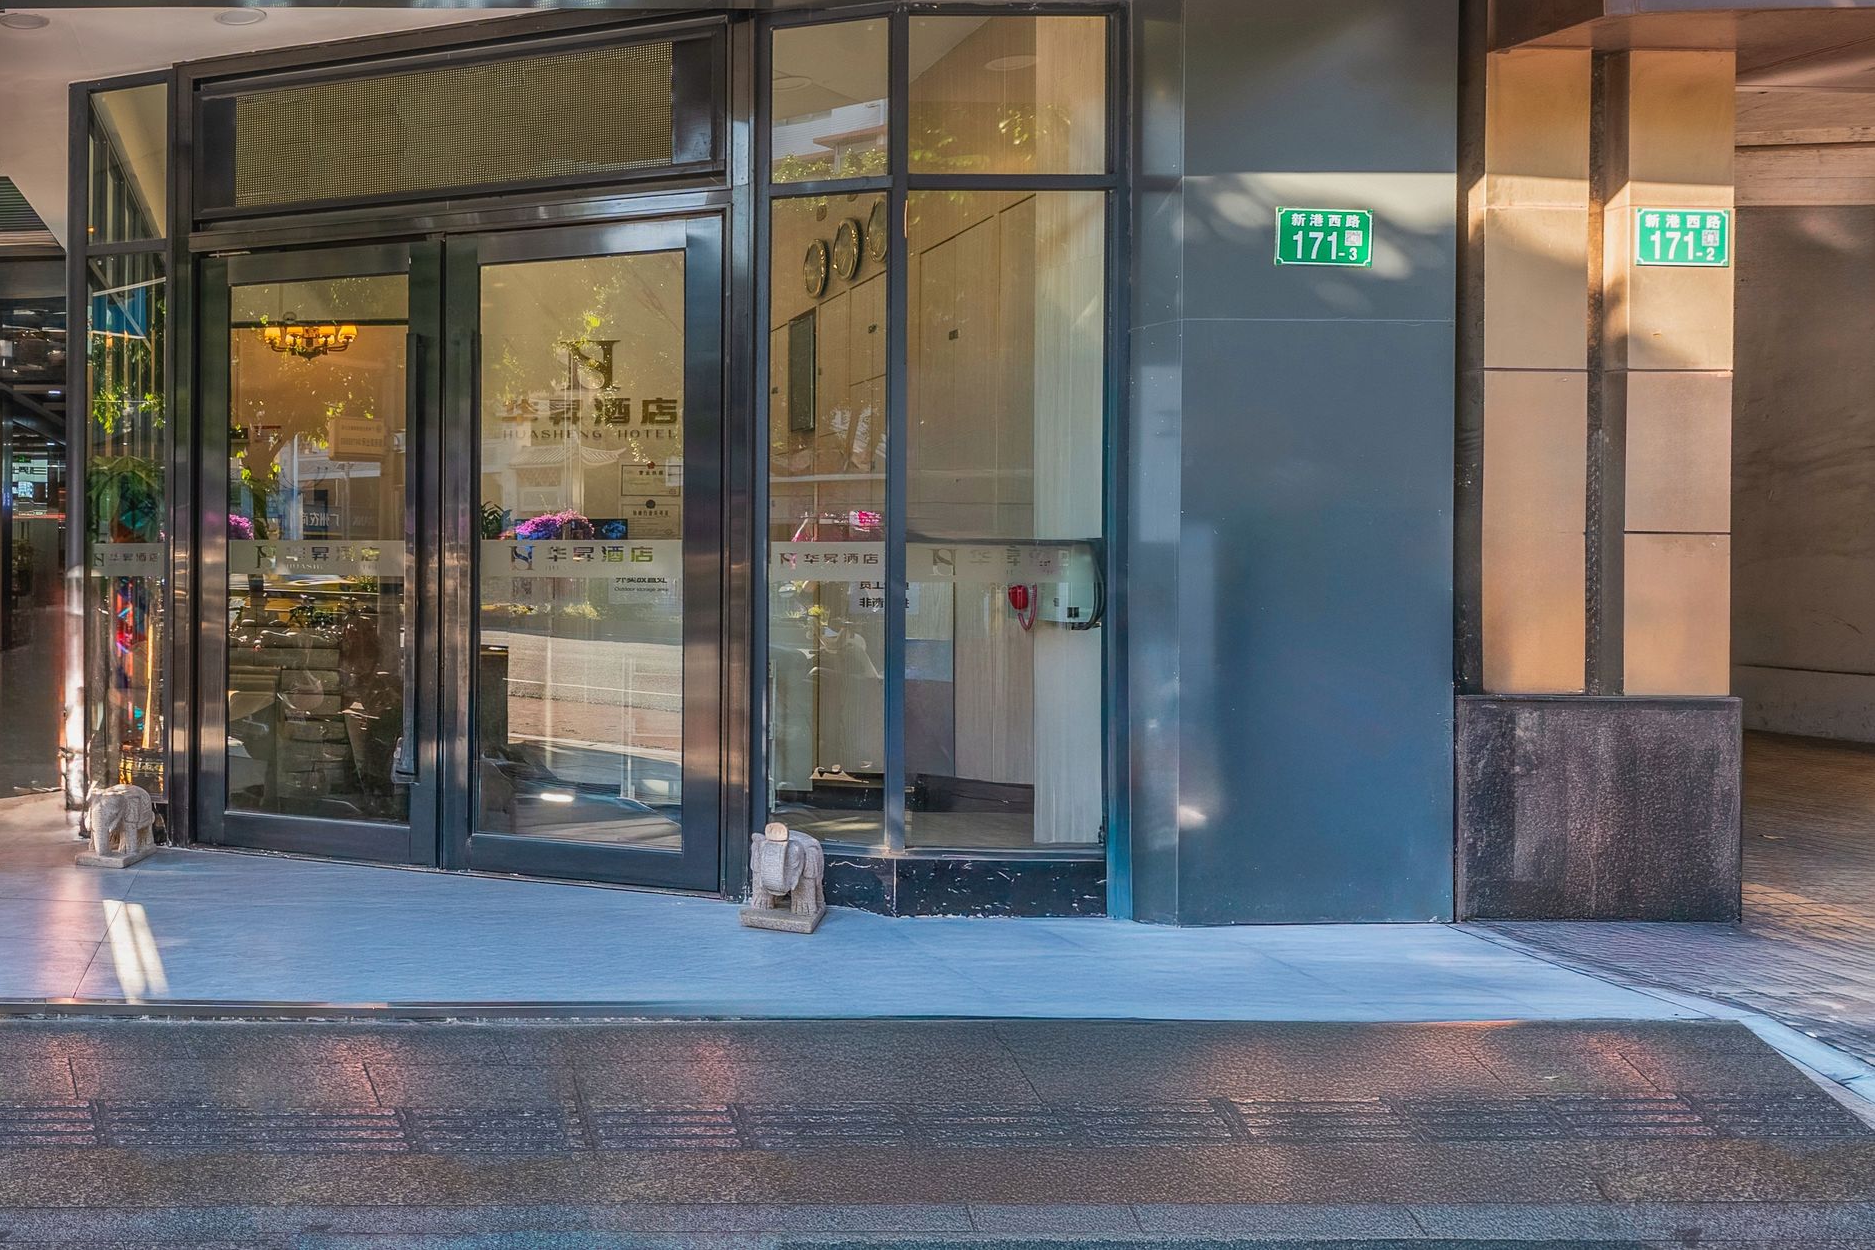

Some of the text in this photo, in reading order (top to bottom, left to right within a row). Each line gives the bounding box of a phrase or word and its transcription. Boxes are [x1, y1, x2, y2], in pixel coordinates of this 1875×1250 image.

[1291, 213, 1360, 228] 新港西路
[1645, 214, 1721, 229] 新港西路
[1293, 230, 1358, 261] 171-3
[1650, 230, 1715, 261] 171-2
[502, 397, 678, 425] 华昇酒店
[618, 429, 676, 440] HOTEL
[547, 546, 653, 562] 华昇酒店
[804, 553, 879, 564] 华昇酒店
